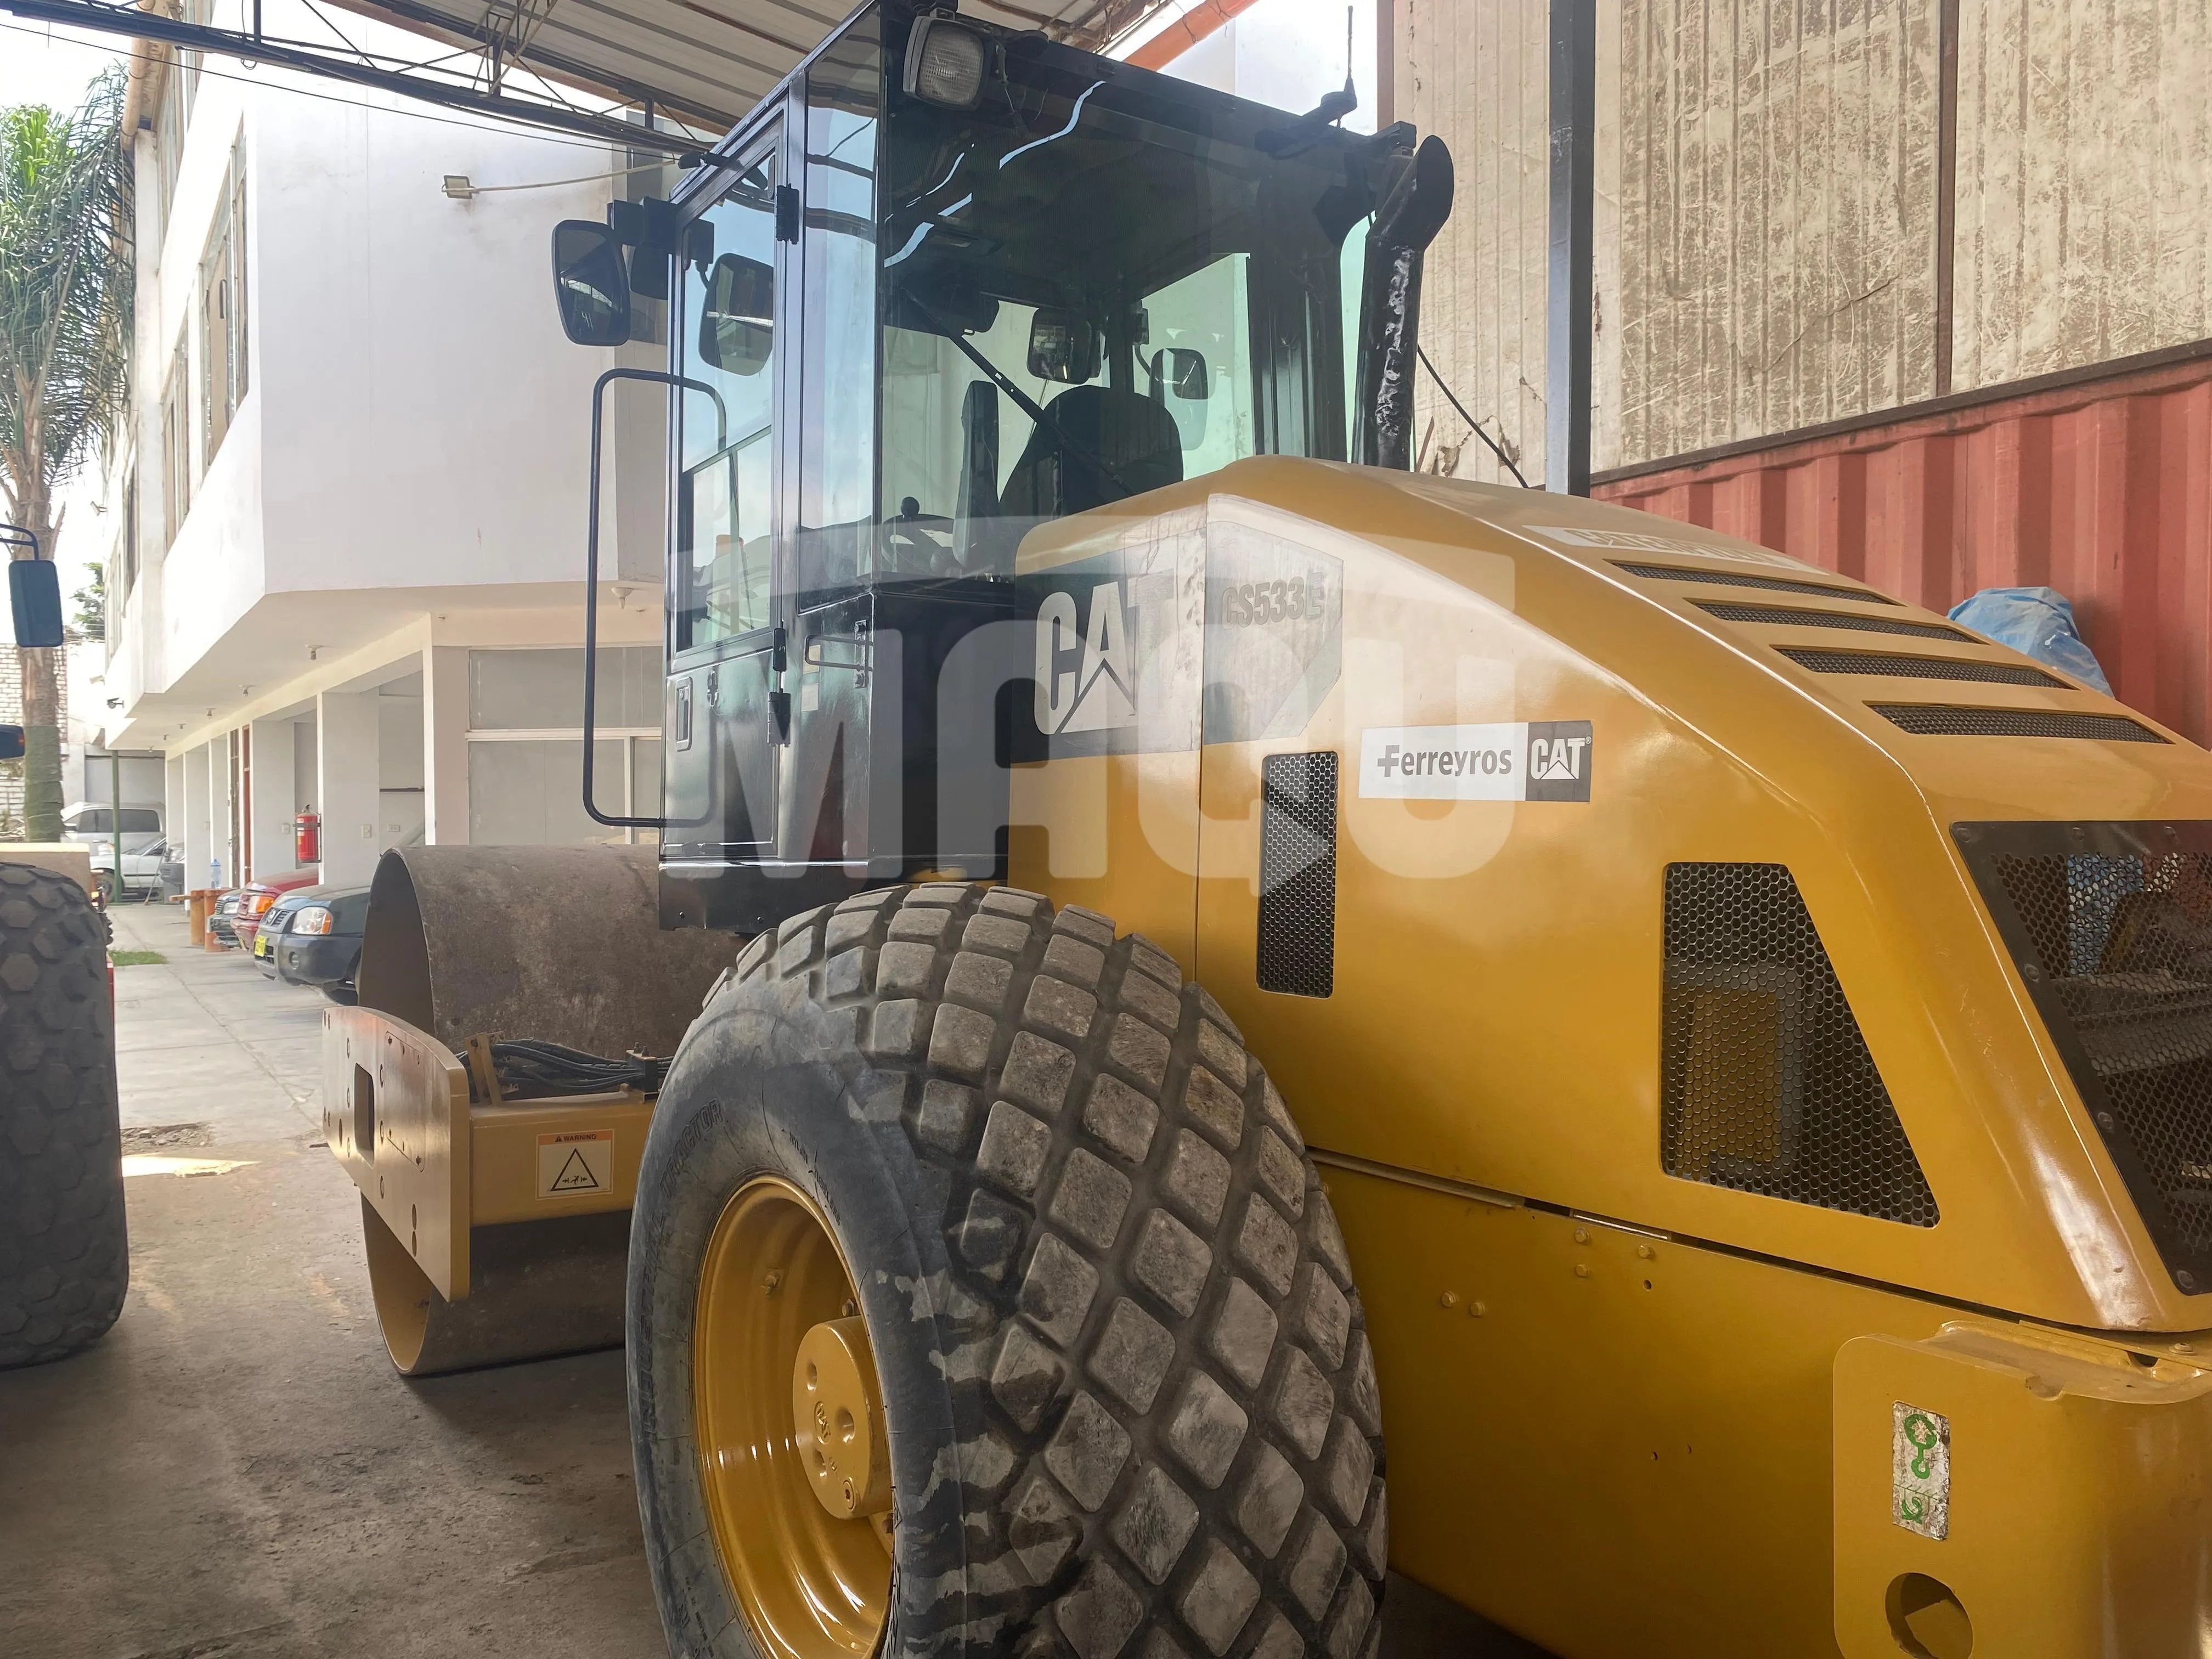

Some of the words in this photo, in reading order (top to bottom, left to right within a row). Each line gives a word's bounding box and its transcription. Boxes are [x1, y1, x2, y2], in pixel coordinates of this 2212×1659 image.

[1221, 567, 1326, 630] CS533E
[1034, 568, 1174, 736] CAT
[1376, 744, 1512, 777] Ferreyros
[563, 1133, 597, 1142] WARNING
[660, 1099, 723, 1199] TRACTOR
